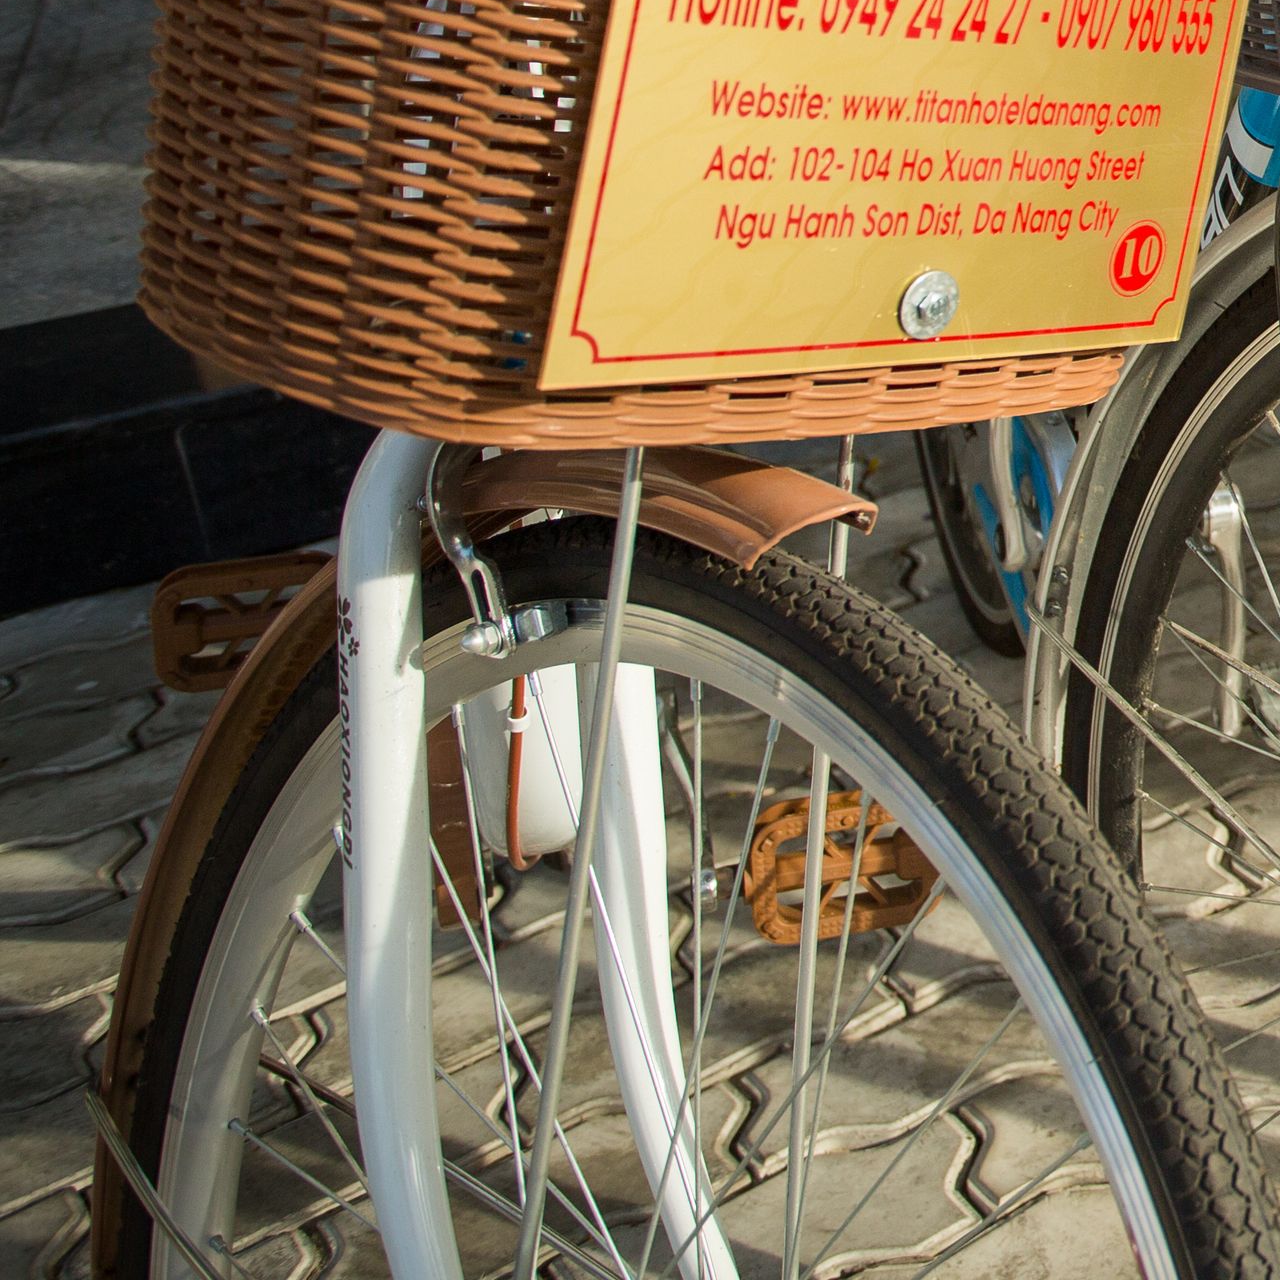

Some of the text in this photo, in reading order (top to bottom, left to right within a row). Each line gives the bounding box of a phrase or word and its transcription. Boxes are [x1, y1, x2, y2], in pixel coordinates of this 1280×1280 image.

[712, 80, 1162, 135] Website: www.titanhoteldanang.com
[703, 145, 1145, 190] Add: 102-104 Ho Xuan Huong Street
[715, 200, 1120, 250] Ngu Hanh Son Dist, Da Nang City
[1119, 238, 1161, 283] 10
